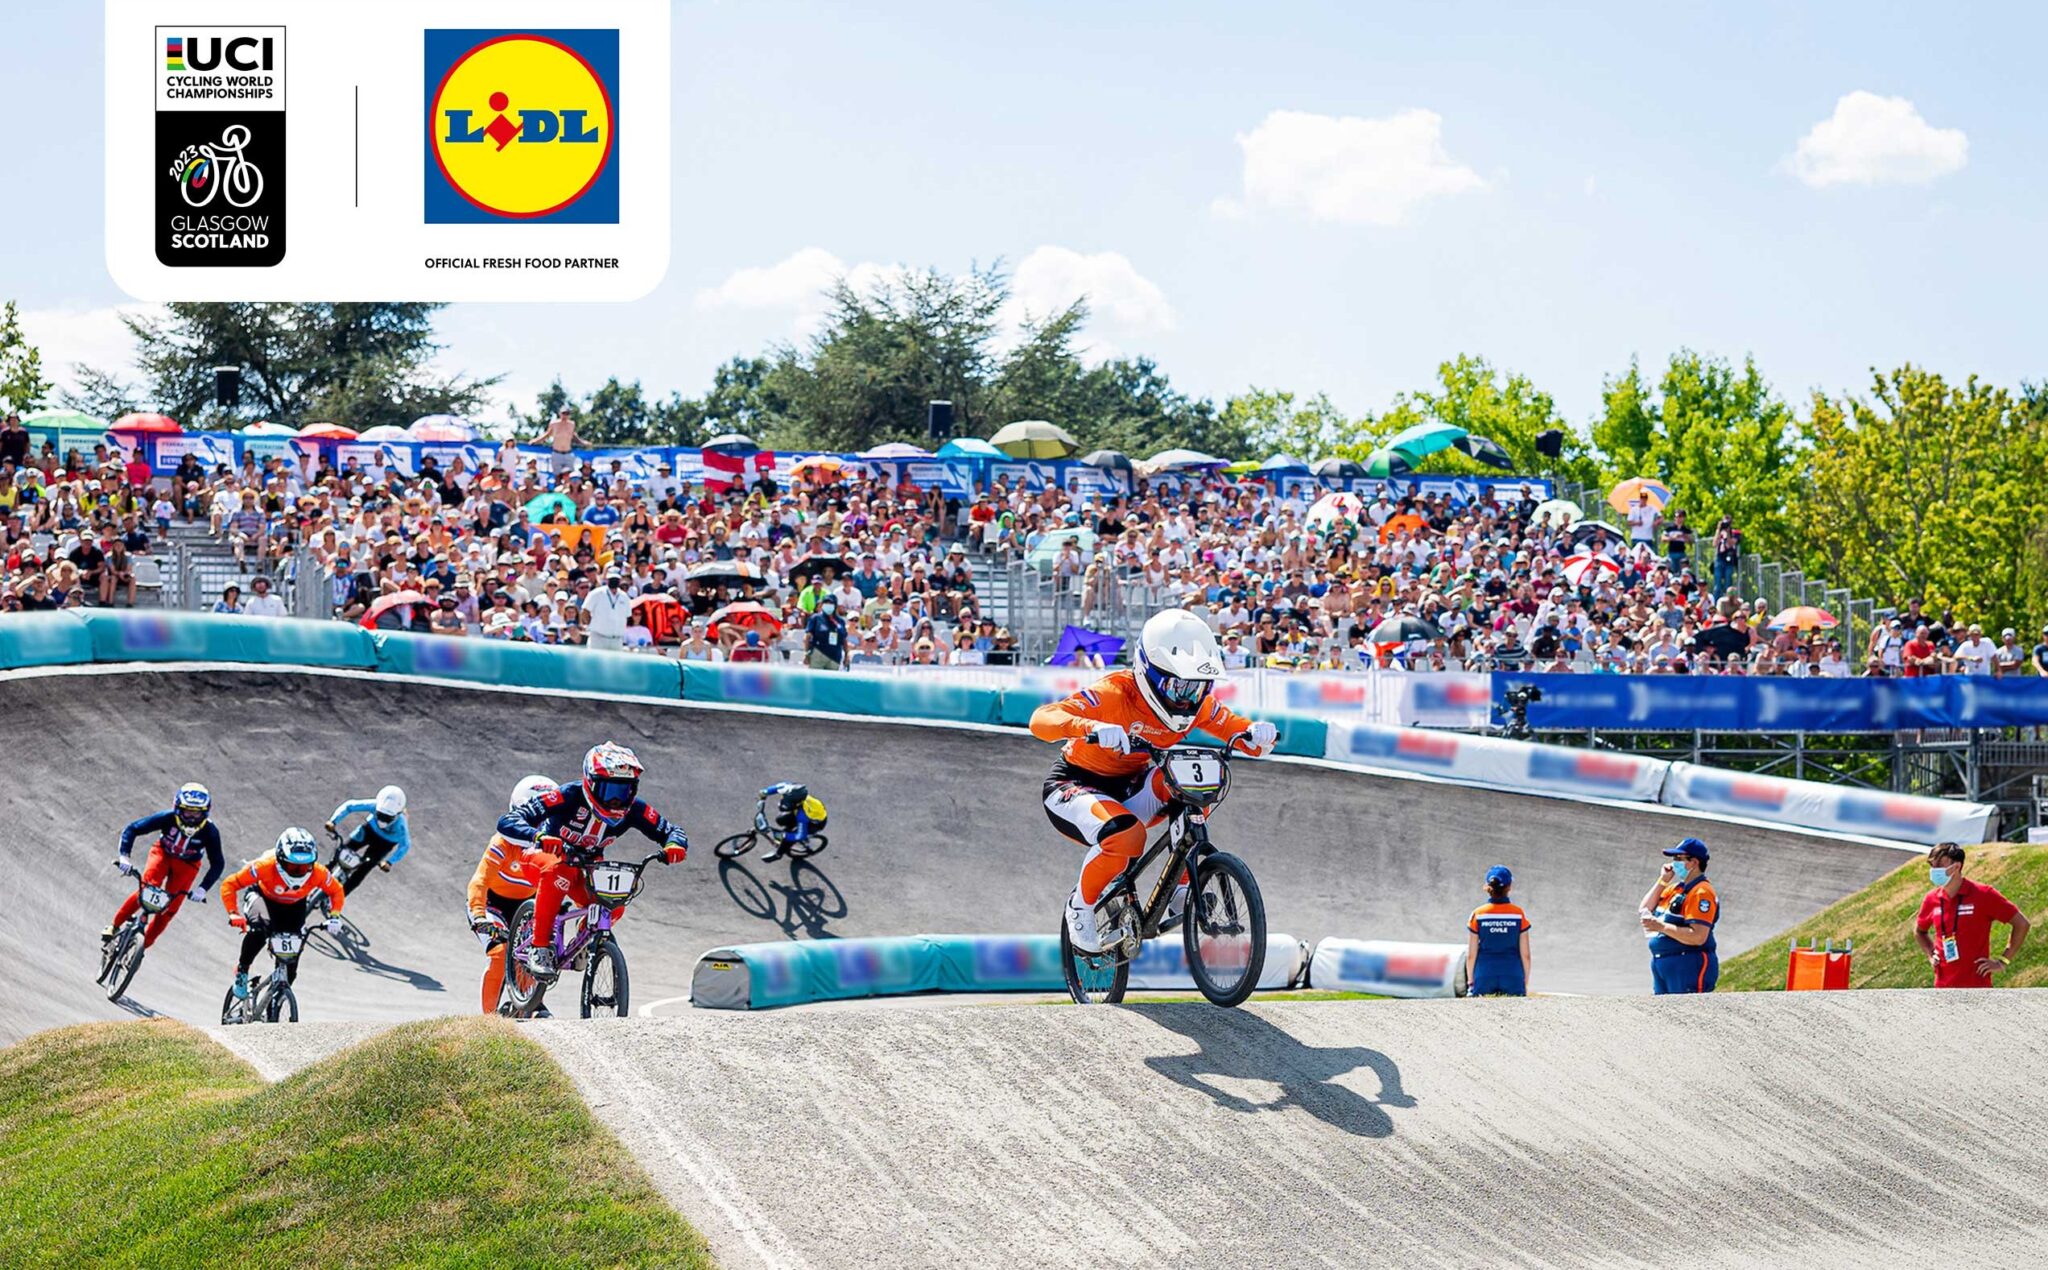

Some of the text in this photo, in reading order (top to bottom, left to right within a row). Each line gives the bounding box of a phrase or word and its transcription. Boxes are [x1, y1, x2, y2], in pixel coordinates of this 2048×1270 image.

[1191, 762, 1204, 783] 3
[559, 825, 618, 849] USA
[607, 874, 620, 891] 11
[150, 893, 160, 905] 15
[281, 940, 292, 952] 61
